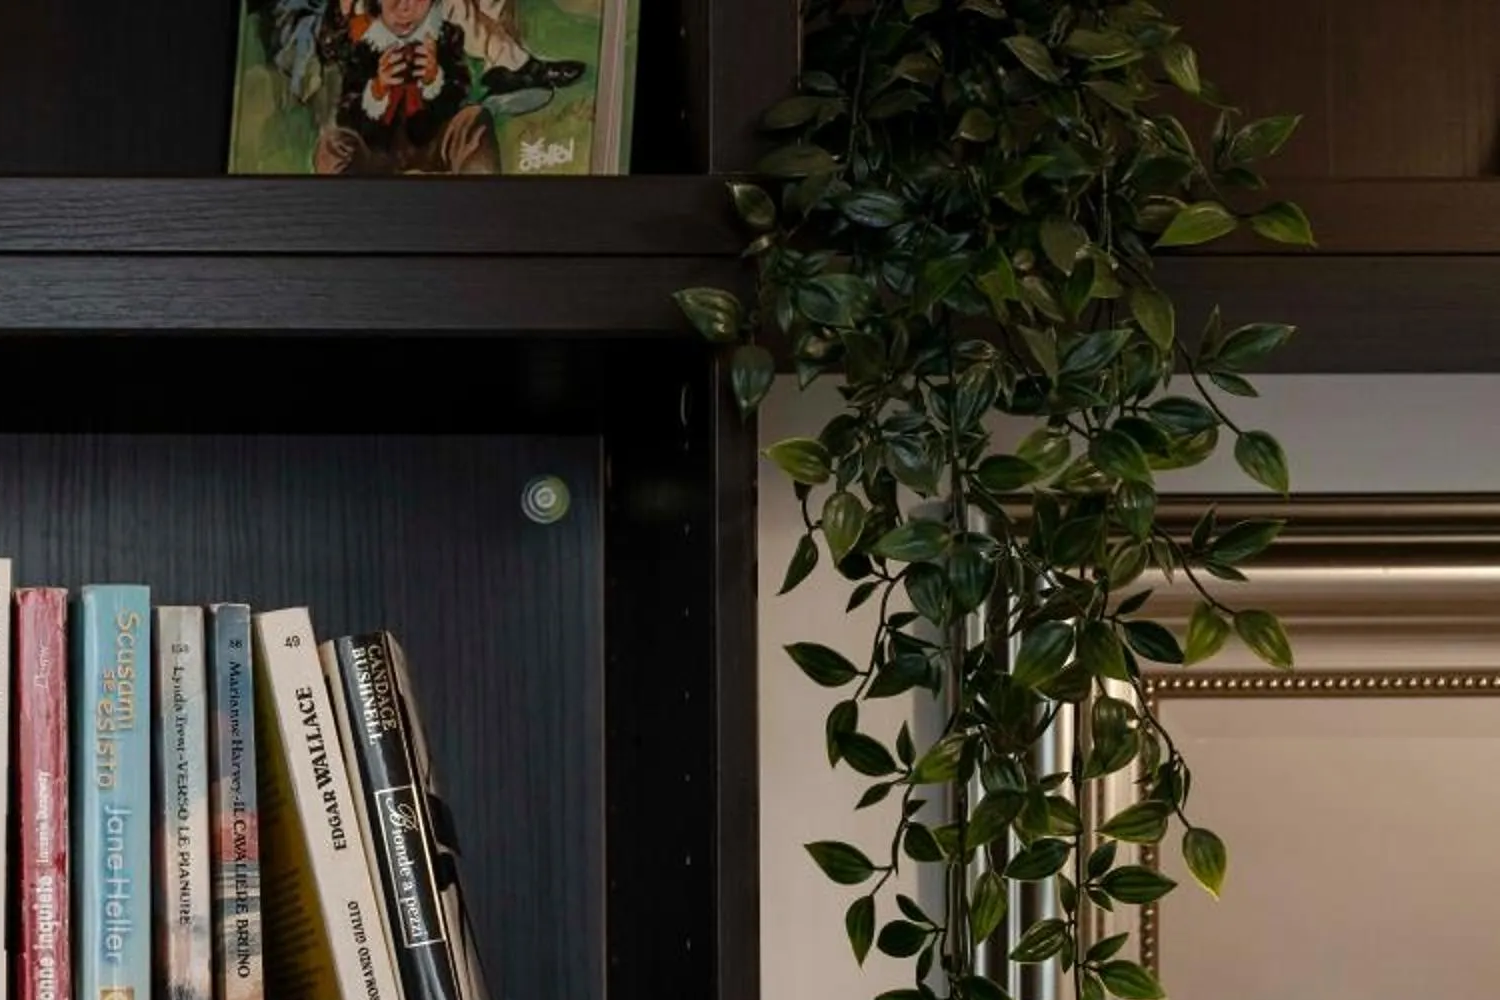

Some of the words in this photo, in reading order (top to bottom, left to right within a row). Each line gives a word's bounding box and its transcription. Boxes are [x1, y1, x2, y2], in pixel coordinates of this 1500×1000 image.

[115, 609, 142, 732] Scusami
[351, 645, 384, 746] BUSHNELL
[367, 644, 397, 733] CANDACE
[96, 699, 117, 789] esisto
[295, 683, 334, 790] WALLACE
[104, 804, 134, 871] Jane
[322, 789, 349, 852] EDGAR
[104, 878, 132, 965] Heller
[178, 850, 192, 926] PIANURE
[346, 900, 367, 946] GIALLO
[400, 895, 429, 941] pezzi
[236, 919, 251, 979] BRUNO
